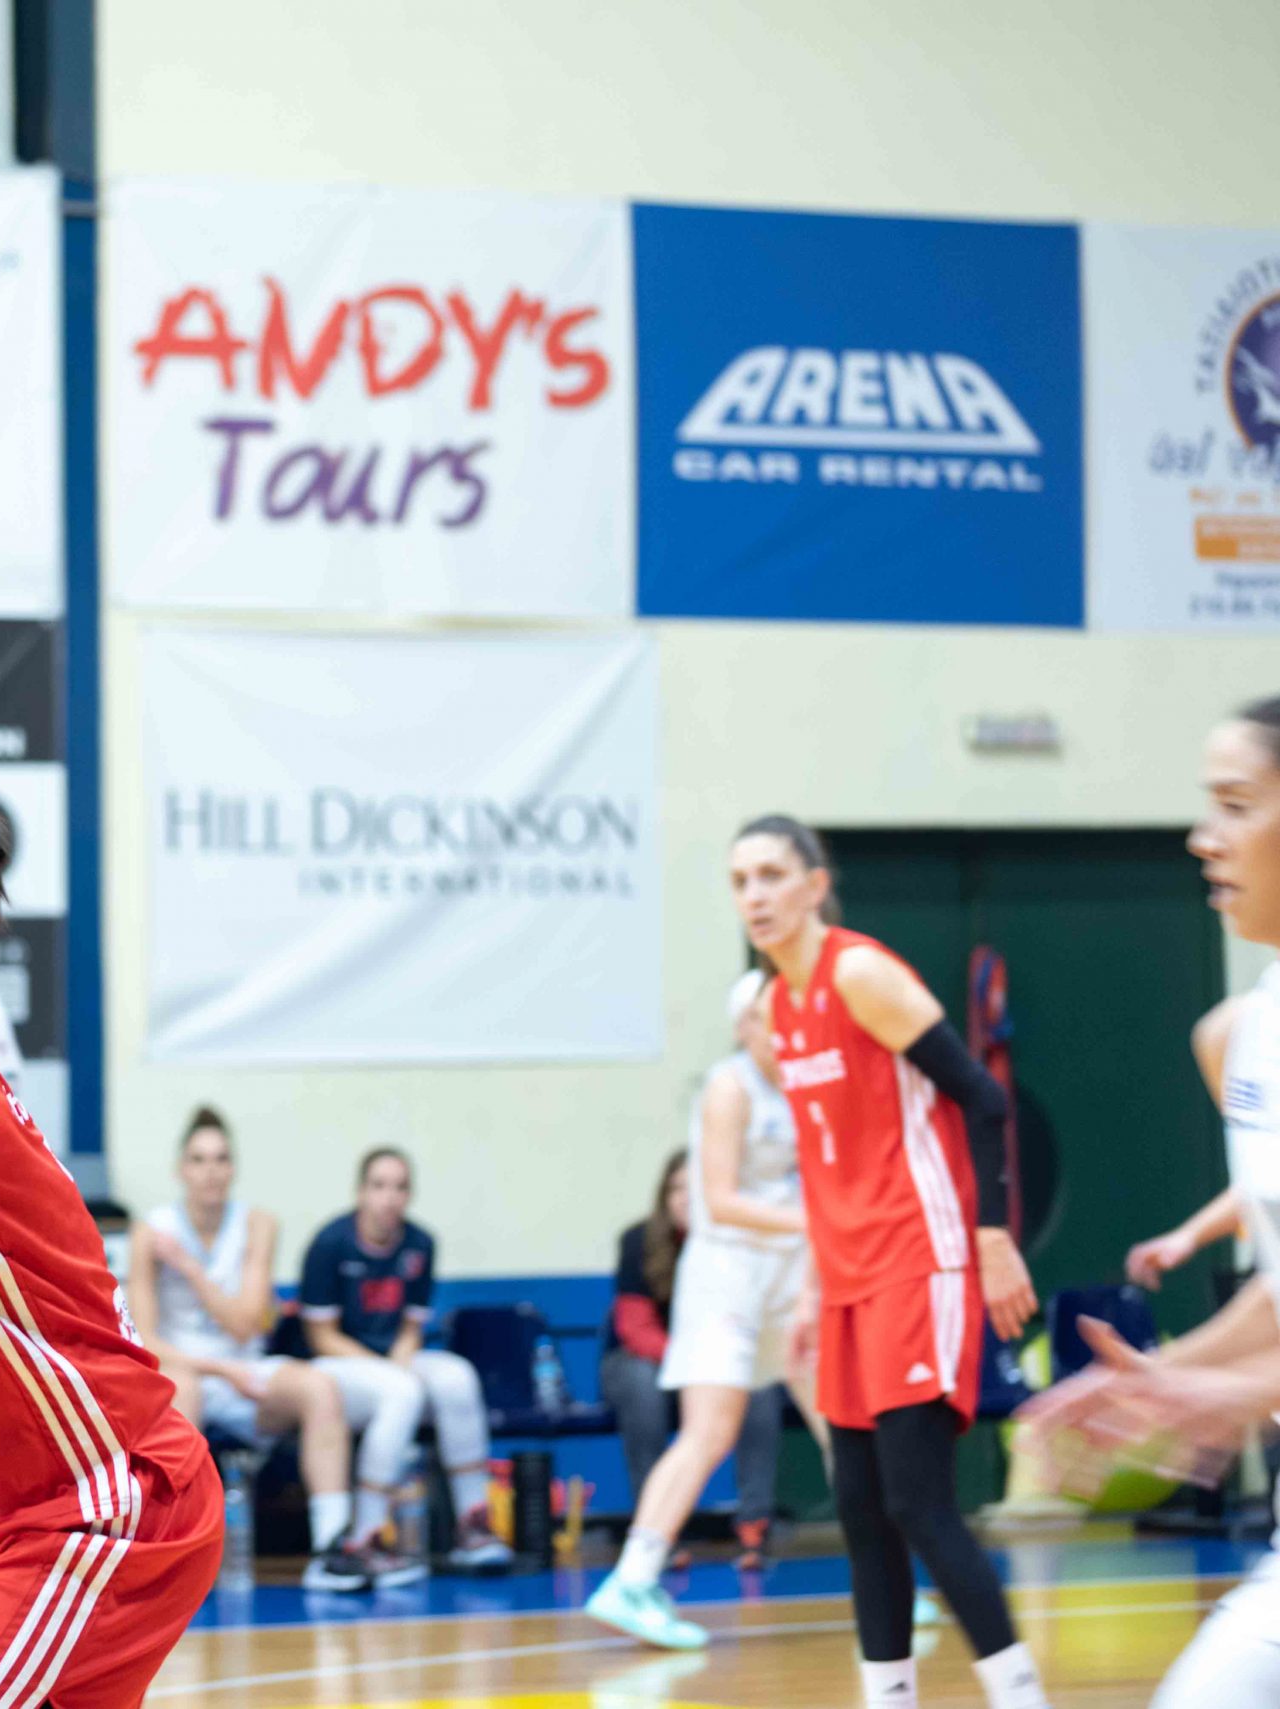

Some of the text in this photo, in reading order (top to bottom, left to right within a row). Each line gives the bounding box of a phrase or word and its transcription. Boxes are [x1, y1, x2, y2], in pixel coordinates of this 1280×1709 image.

[676, 346, 1043, 456] ARENA
[201, 418, 492, 529] Tours
[673, 450, 1044, 493] CAR RENTAL
[164, 786, 640, 858] HILL DICKINSON
[299, 867, 638, 899] INTERNATIONAL
